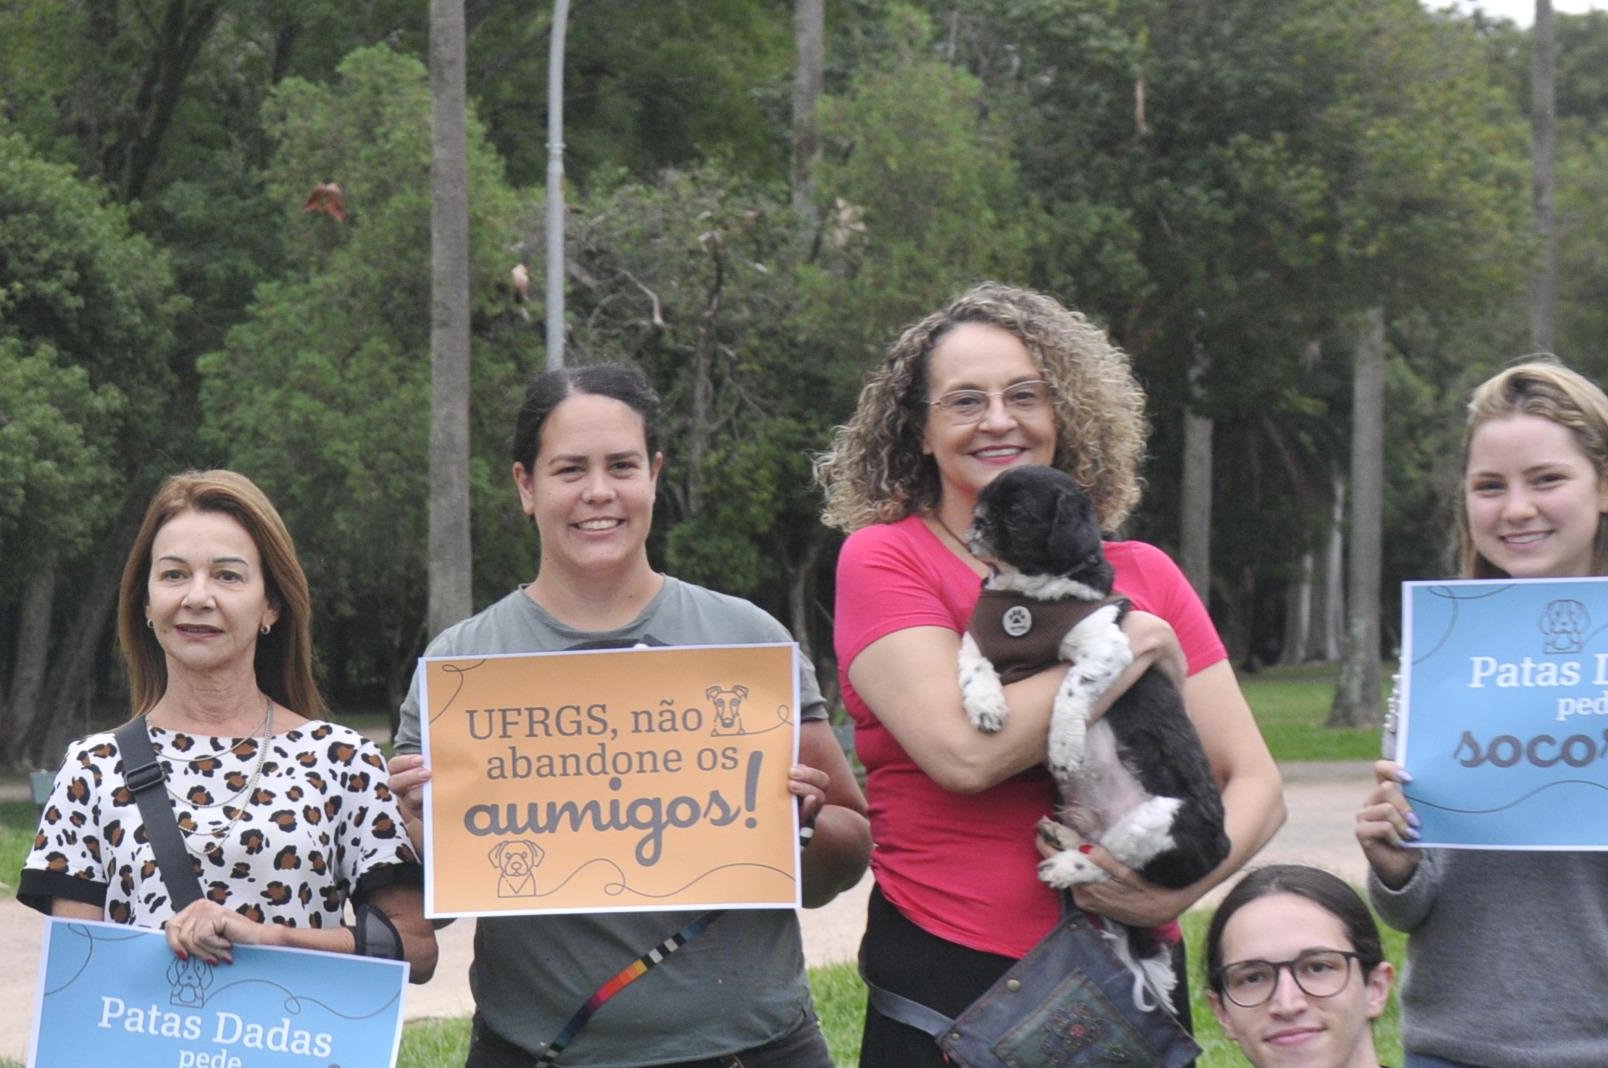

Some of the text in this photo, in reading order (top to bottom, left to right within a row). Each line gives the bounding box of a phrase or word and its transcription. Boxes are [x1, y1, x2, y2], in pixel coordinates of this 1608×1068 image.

[1467, 656, 1582, 688] Patas
[465, 699, 703, 740] UFRGS, não
[1556, 690, 1608, 721] ped
[486, 743, 739, 780] abandone os
[464, 750, 764, 867] aumigos!
[98, 996, 333, 1058] Patas Dadas
